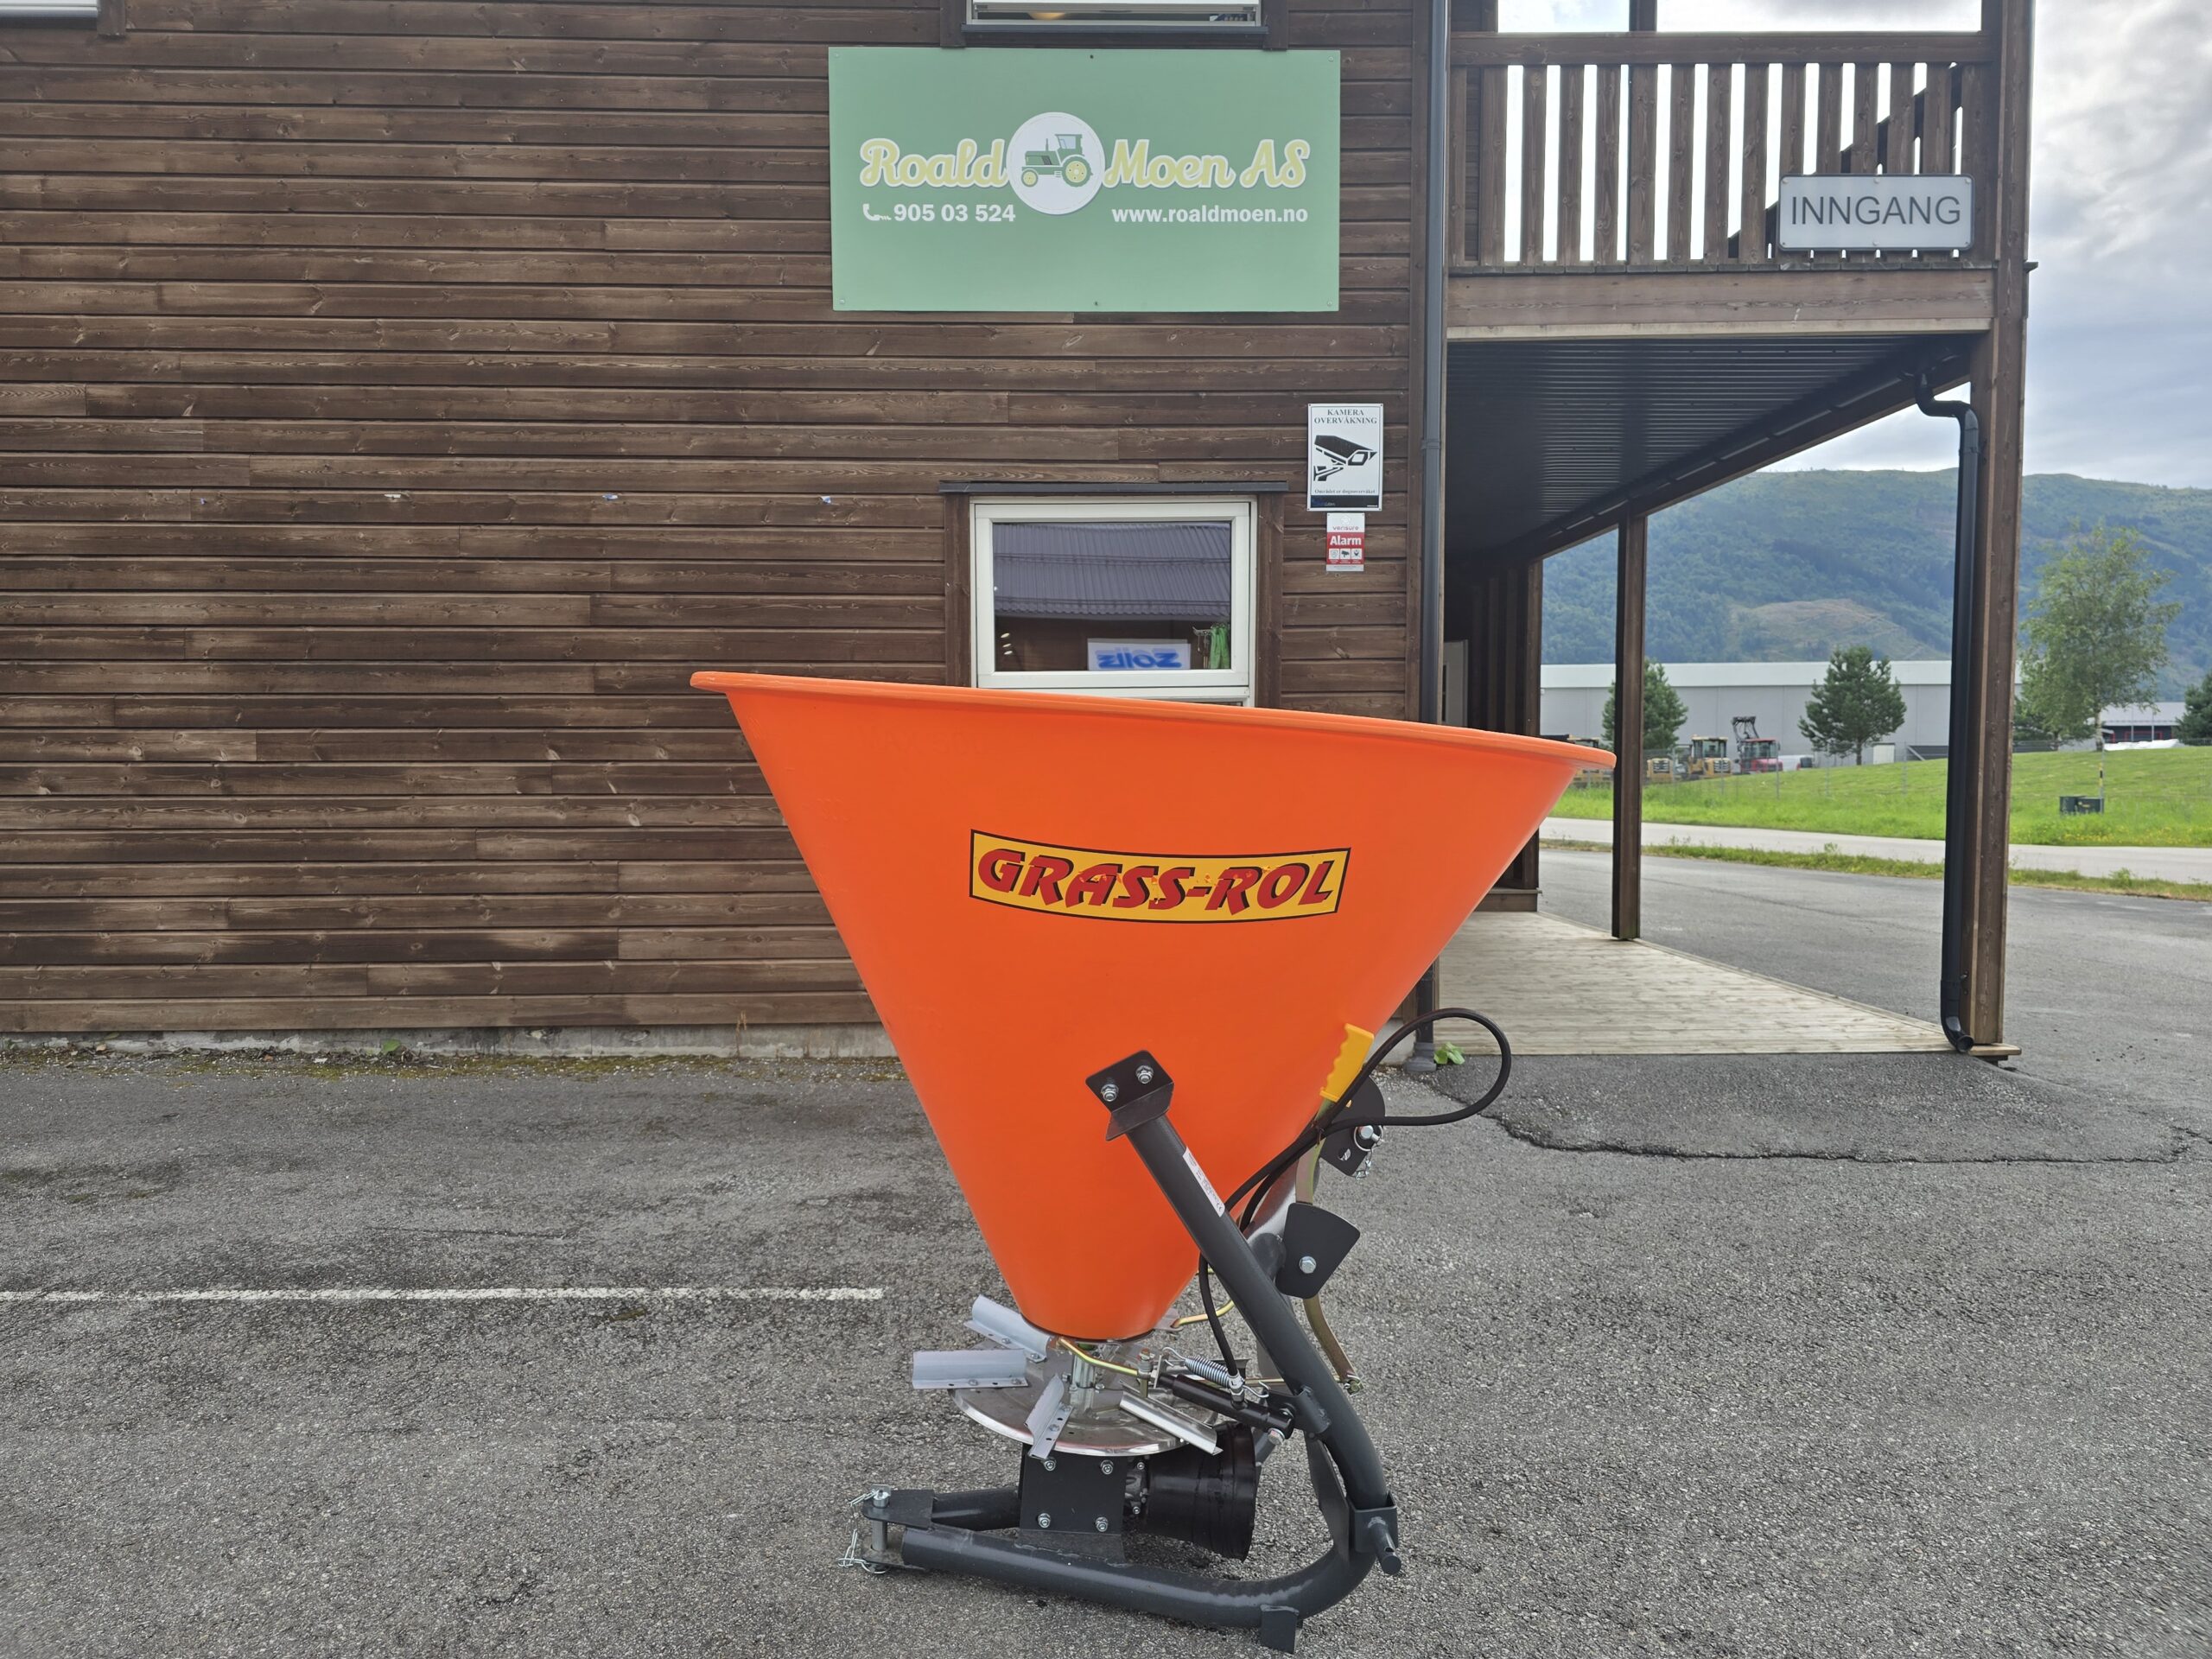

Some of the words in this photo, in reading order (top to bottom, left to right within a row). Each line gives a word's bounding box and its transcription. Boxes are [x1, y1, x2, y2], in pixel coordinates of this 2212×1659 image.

[860, 138, 1009, 188] Roald
[1103, 138, 1236, 188] Moen
[1239, 138, 1311, 188] AS
[893, 203, 936, 223] 905
[940, 203, 969, 223] 03
[975, 203, 1016, 223] 524
[1111, 205, 1309, 223] www.roaldmoen.no
[1791, 195, 1961, 226] INNGANG
[1313, 416, 1377, 424] OVERVÅKNING
[1329, 535, 1362, 546] Alarm
[978, 848, 1336, 916] GRASS-ROL
